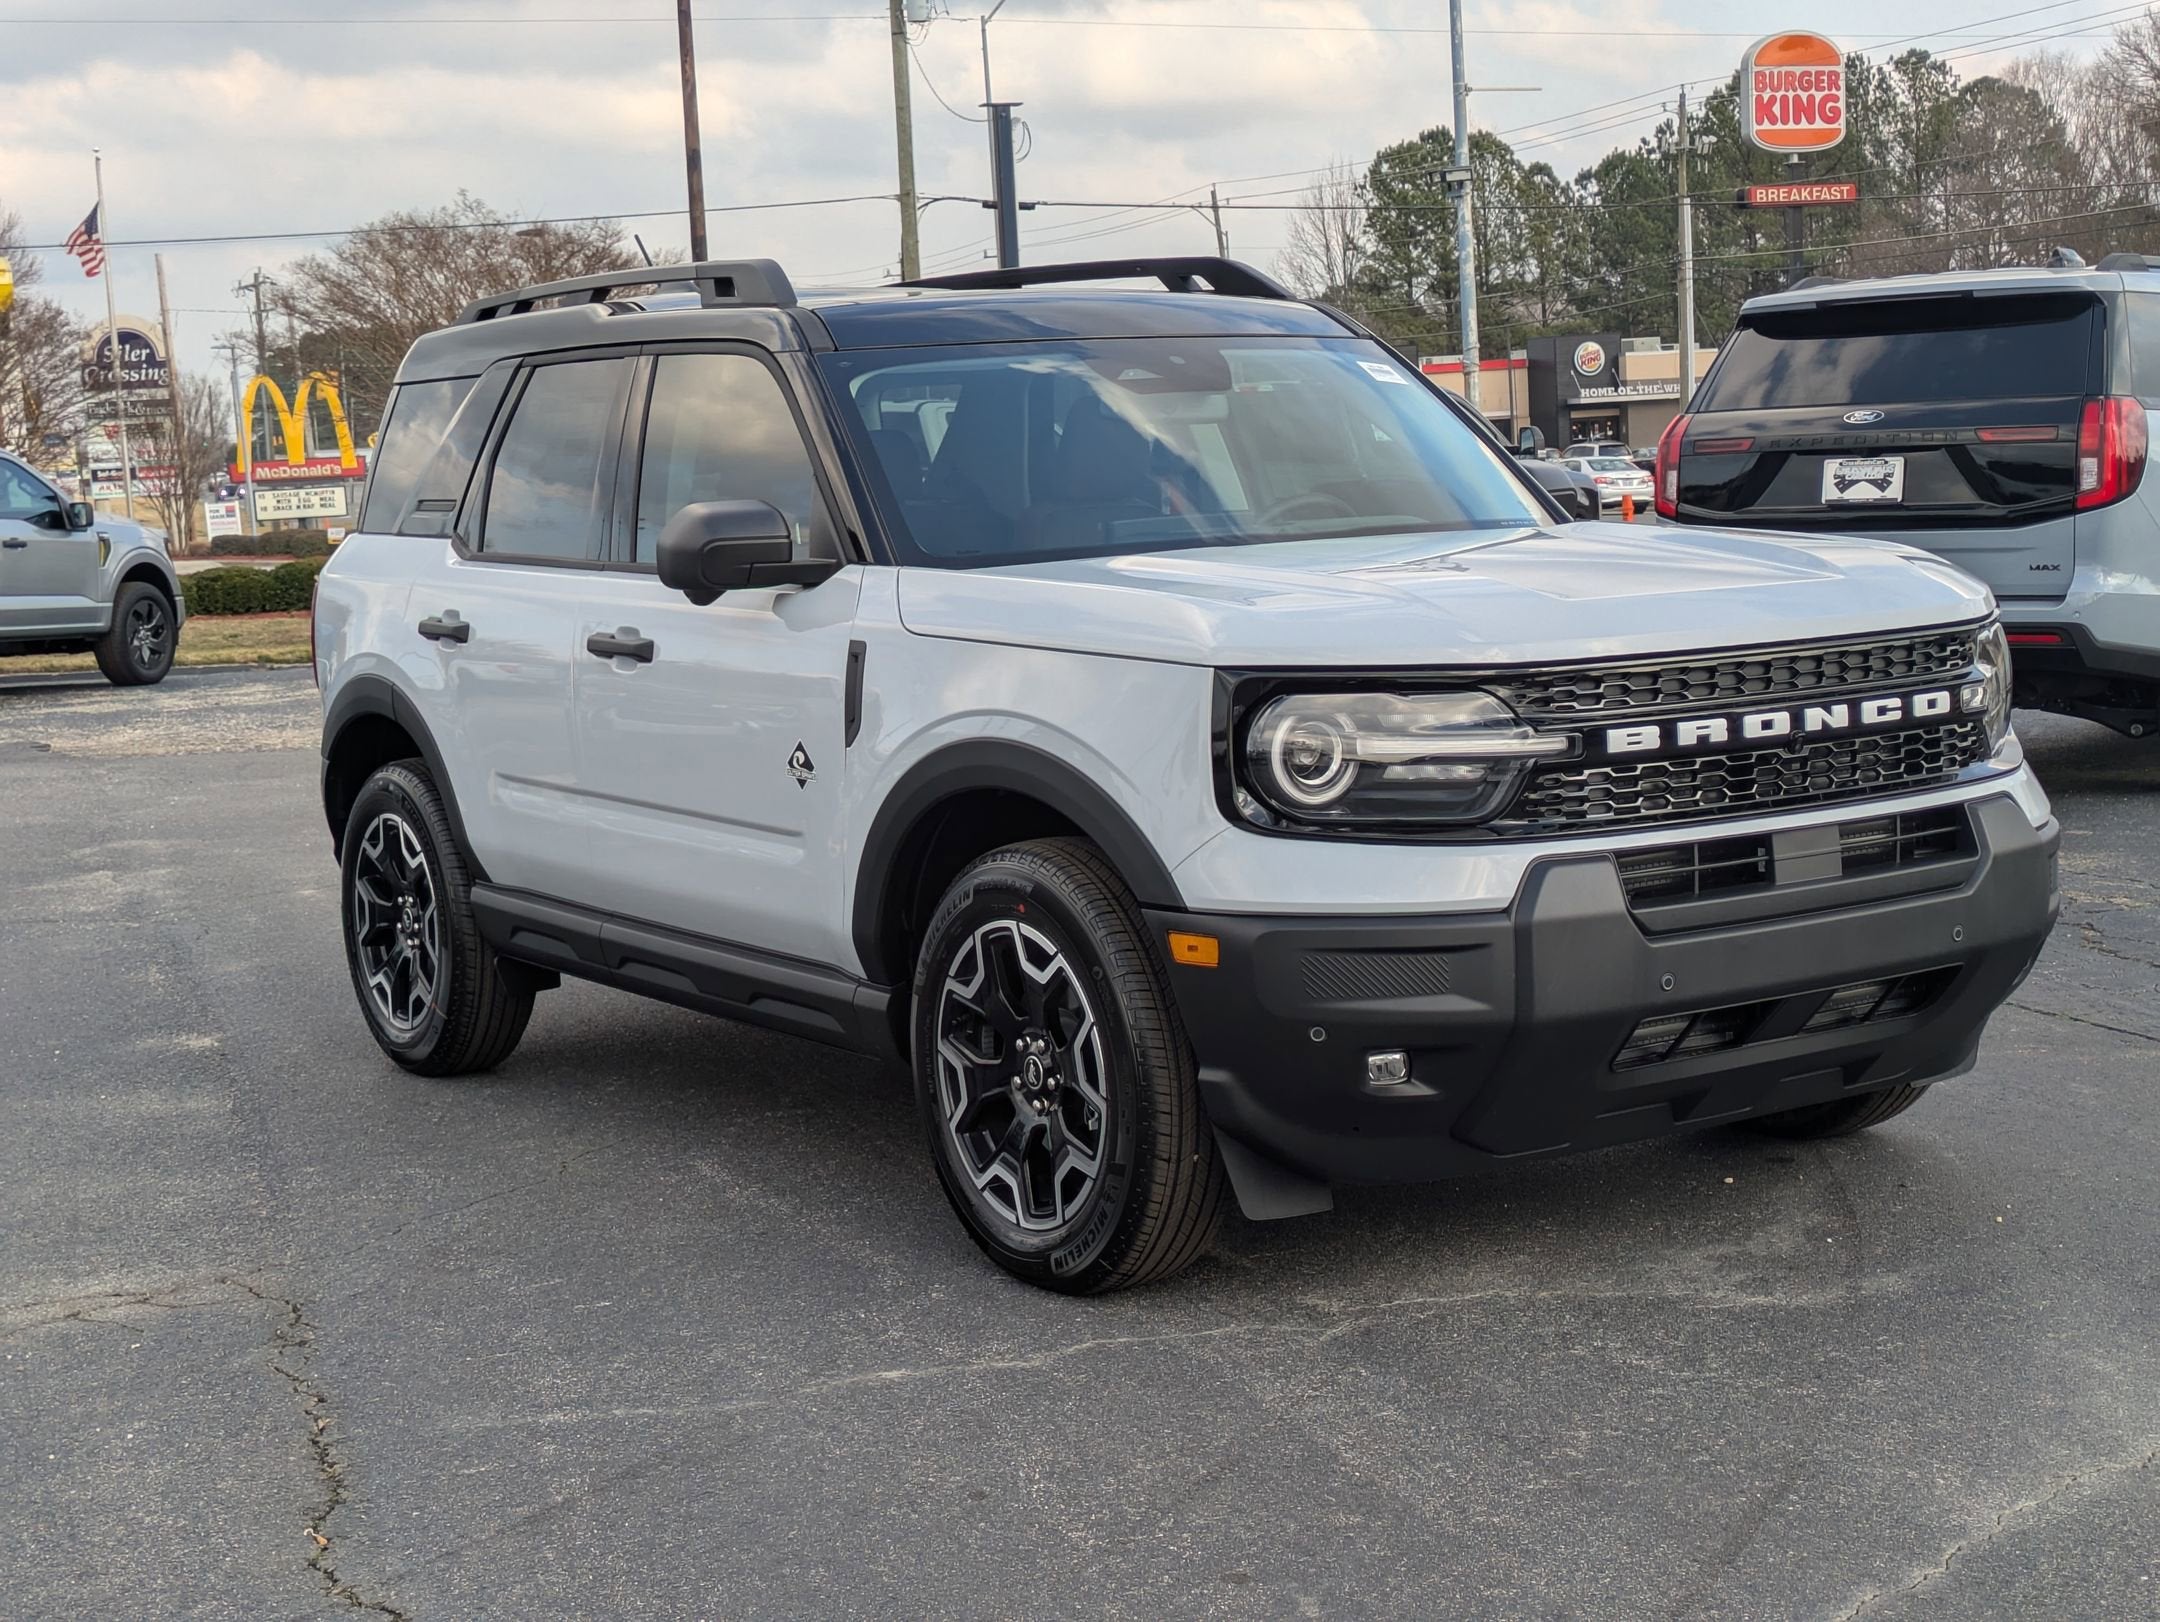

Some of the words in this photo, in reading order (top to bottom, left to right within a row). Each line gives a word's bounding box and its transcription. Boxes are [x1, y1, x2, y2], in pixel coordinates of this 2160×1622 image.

[1754, 70, 1841, 93] BURGER
[1755, 94, 1841, 126] KING
[1756, 186, 1850, 203] BREAKFAST
[1580, 354, 1602, 368] KING
[1580, 387, 1617, 398] HOME
[1618, 386, 1637, 396] OF
[1638, 384, 1664, 395] THE
[1850, 410, 1878, 421] Ford
[1769, 431, 1957, 449] EXPEDITION
[255, 464, 342, 479] McDonald's
[1606, 691, 1951, 753] BRONCO
[925, 887, 973, 954] MICHELIN
[1054, 1205, 1110, 1271] MICHELIN
